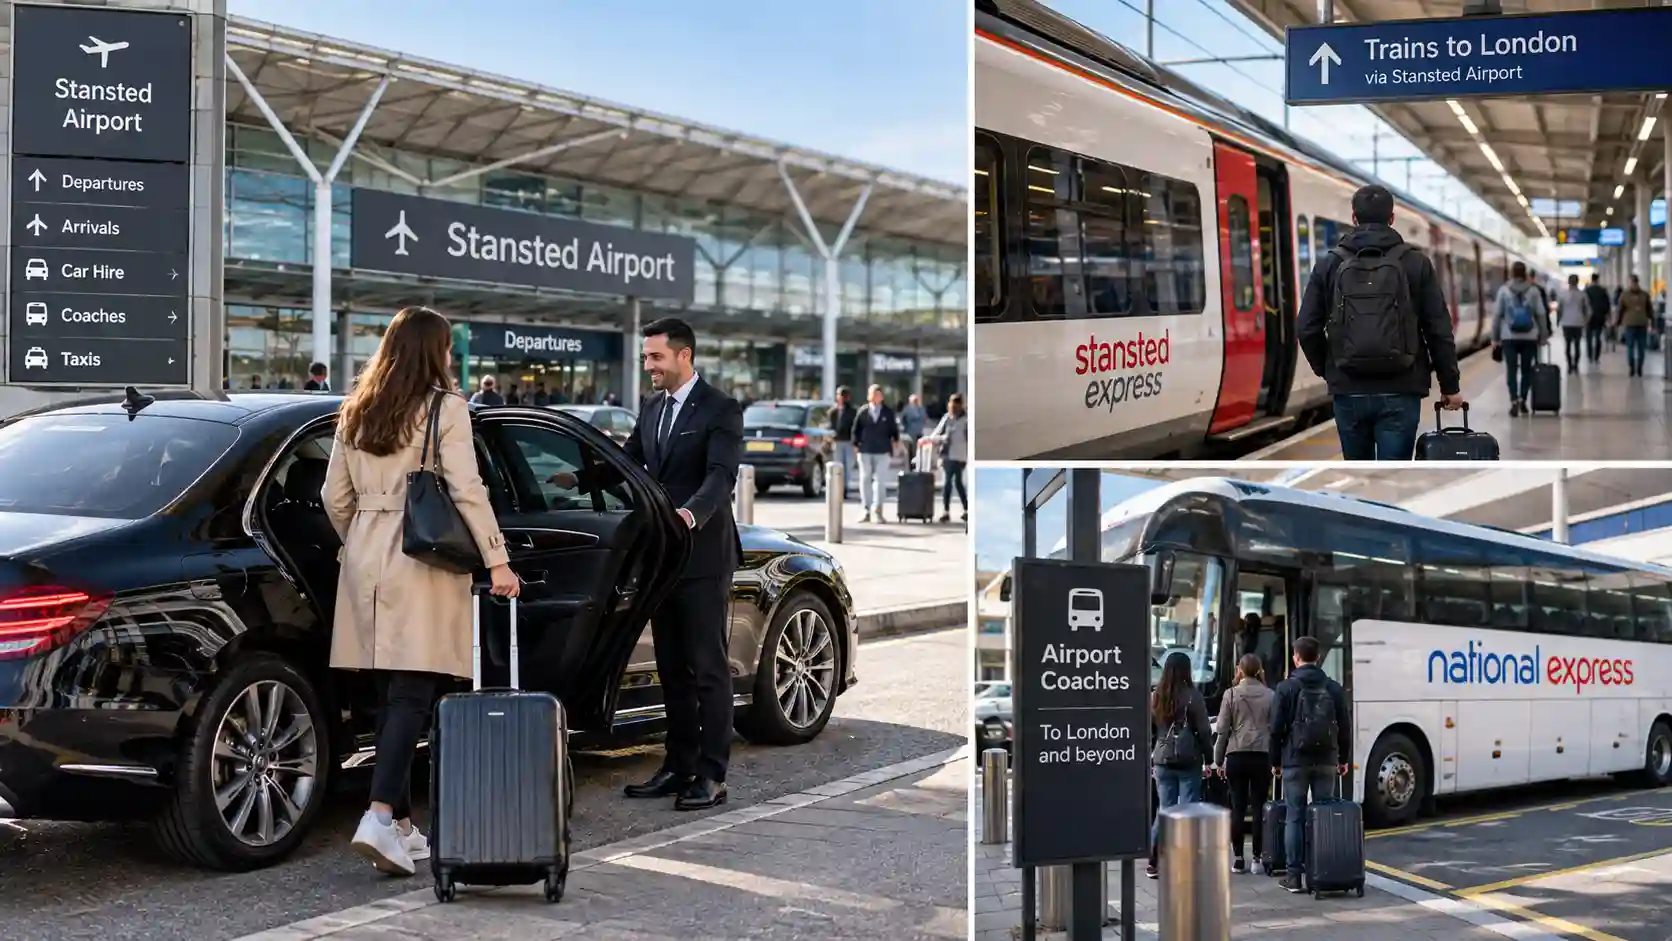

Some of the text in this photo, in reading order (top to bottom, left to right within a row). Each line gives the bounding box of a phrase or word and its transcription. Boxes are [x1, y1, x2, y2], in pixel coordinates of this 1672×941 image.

[1364, 31, 1576, 60] Trains to London
[1365, 66, 1522, 85] via Stansted Airport
[55, 78, 151, 103] Stansted
[63, 109, 142, 134] Airport
[63, 175, 144, 192] Departures
[62, 220, 119, 234] Arrivals
[448, 222, 674, 283] Stansted Airport
[62, 264, 124, 279] Car Hire
[62, 308, 125, 323] Coaches
[505, 331, 582, 353] Departures
[1075, 328, 1170, 374] stansted
[61, 352, 100, 366] Taxis
[1086, 372, 1162, 412] express
[1042, 644, 1121, 668] Airport
[1428, 640, 1633, 694] national express
[1041, 671, 1129, 689] Coaches
[1040, 723, 1129, 740] To London
[1039, 743, 1134, 764] and beyond
